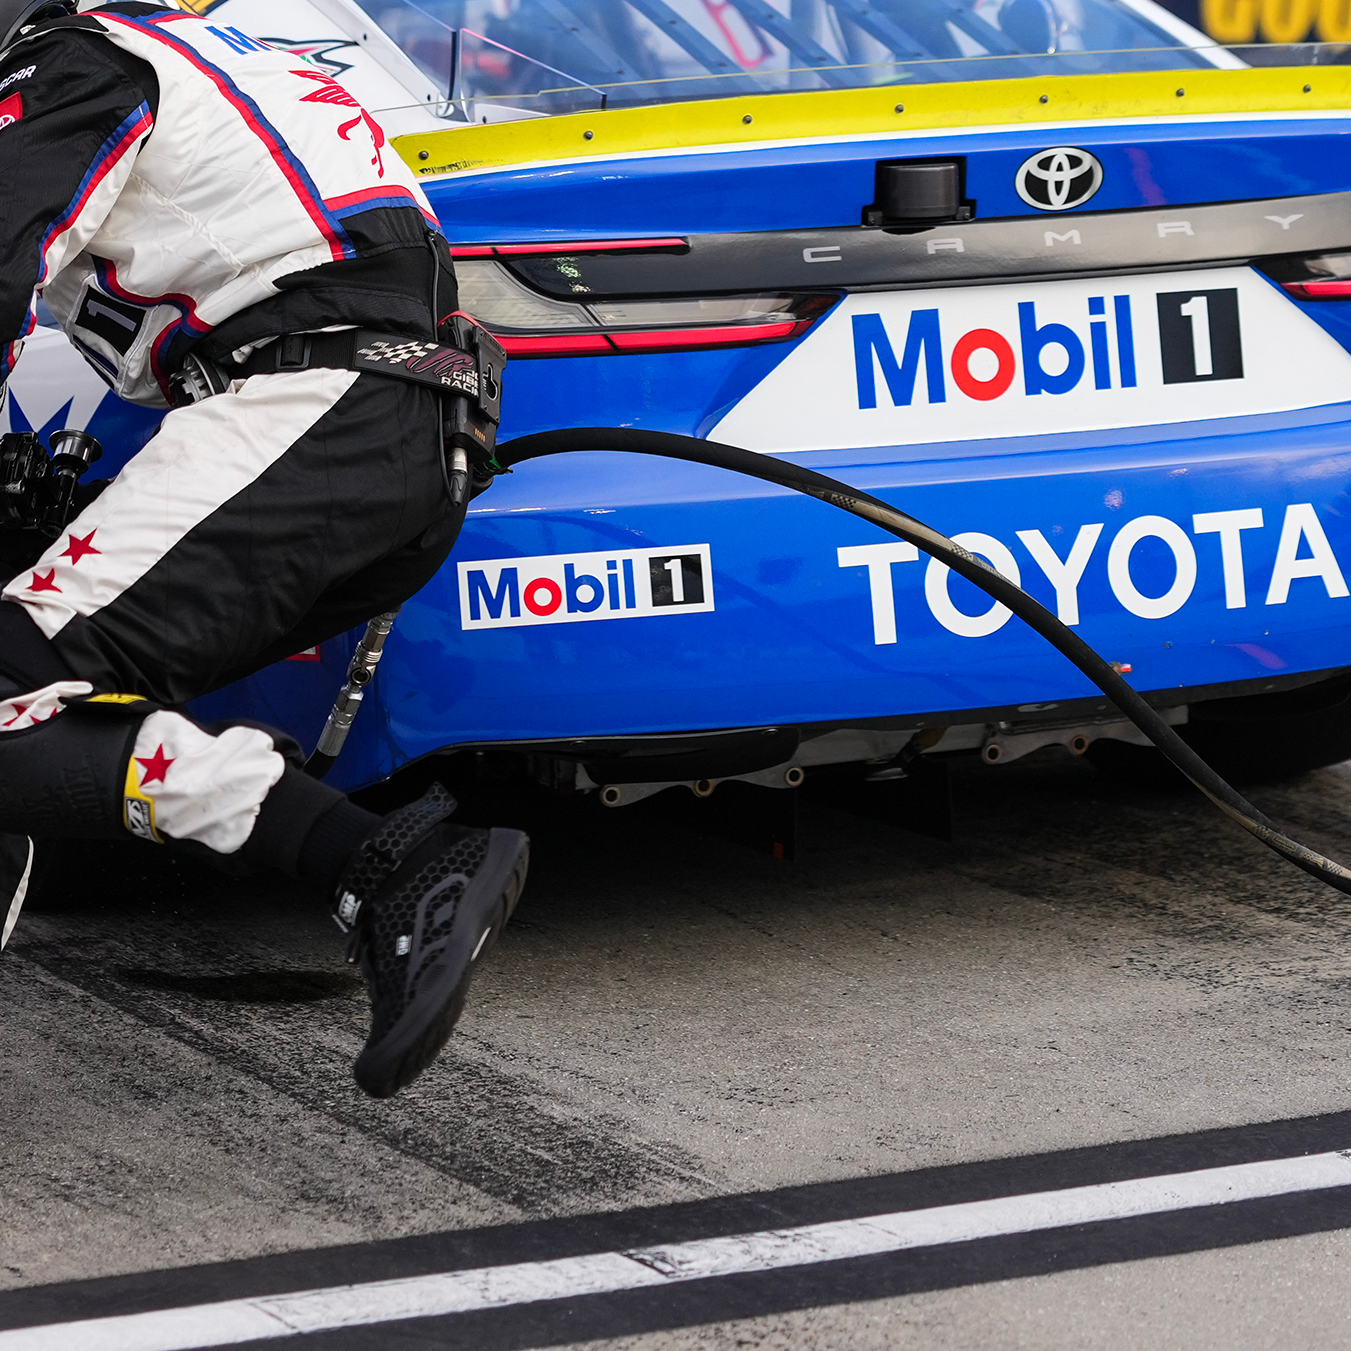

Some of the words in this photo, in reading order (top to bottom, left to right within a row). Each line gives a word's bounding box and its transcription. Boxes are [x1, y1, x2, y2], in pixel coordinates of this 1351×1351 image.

[802, 213, 1305, 264] CAMRY
[850, 294, 1137, 411] Mobil
[1179, 295, 1216, 377] 1
[467, 558, 637, 622] Mobil
[663, 557, 686, 606] 1
[837, 503, 1350, 646] TOYOTA
